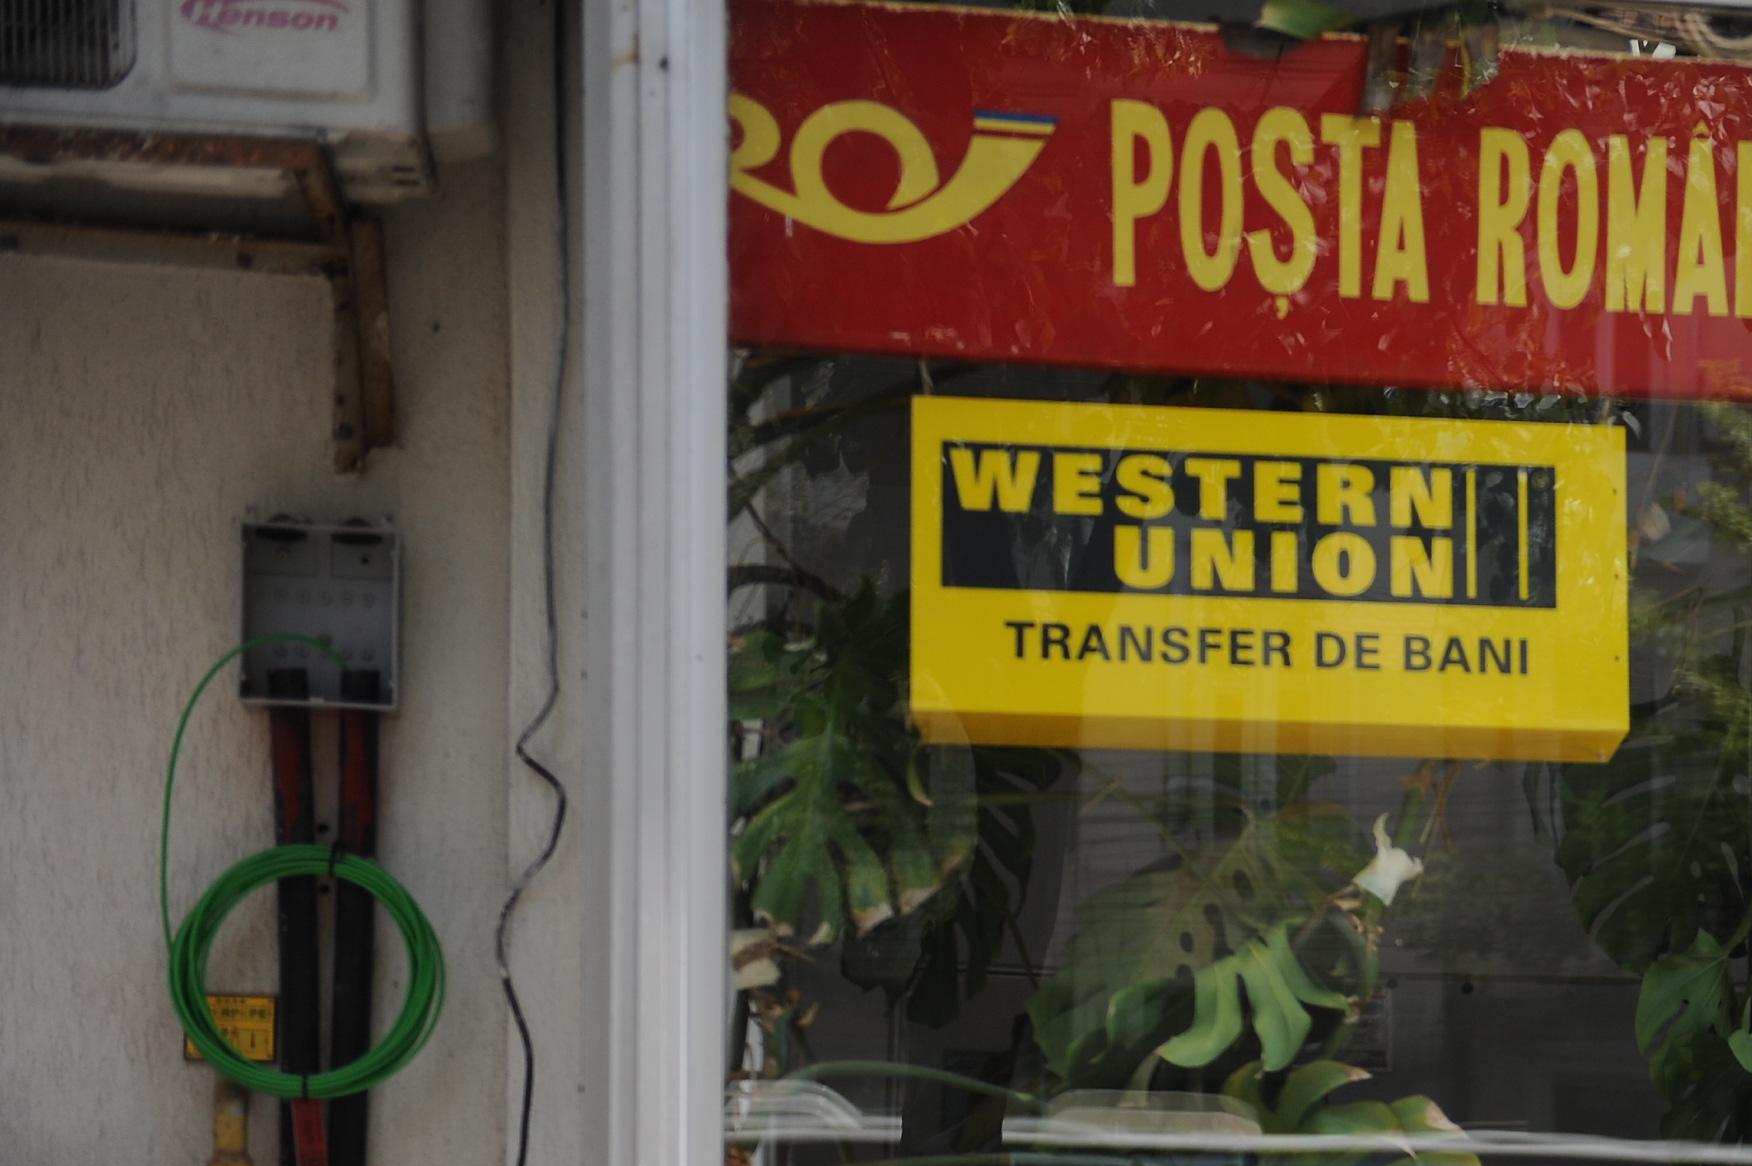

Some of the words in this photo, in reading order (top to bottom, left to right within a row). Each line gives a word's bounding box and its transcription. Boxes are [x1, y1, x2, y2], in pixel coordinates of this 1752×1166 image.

[949, 446, 1454, 530] WESTERN
[1113, 526, 1455, 600] UNION
[1006, 620, 1293, 668] TRANSFER
[1315, 630, 1383, 671] DE
[1401, 636, 1529, 677] BANI
